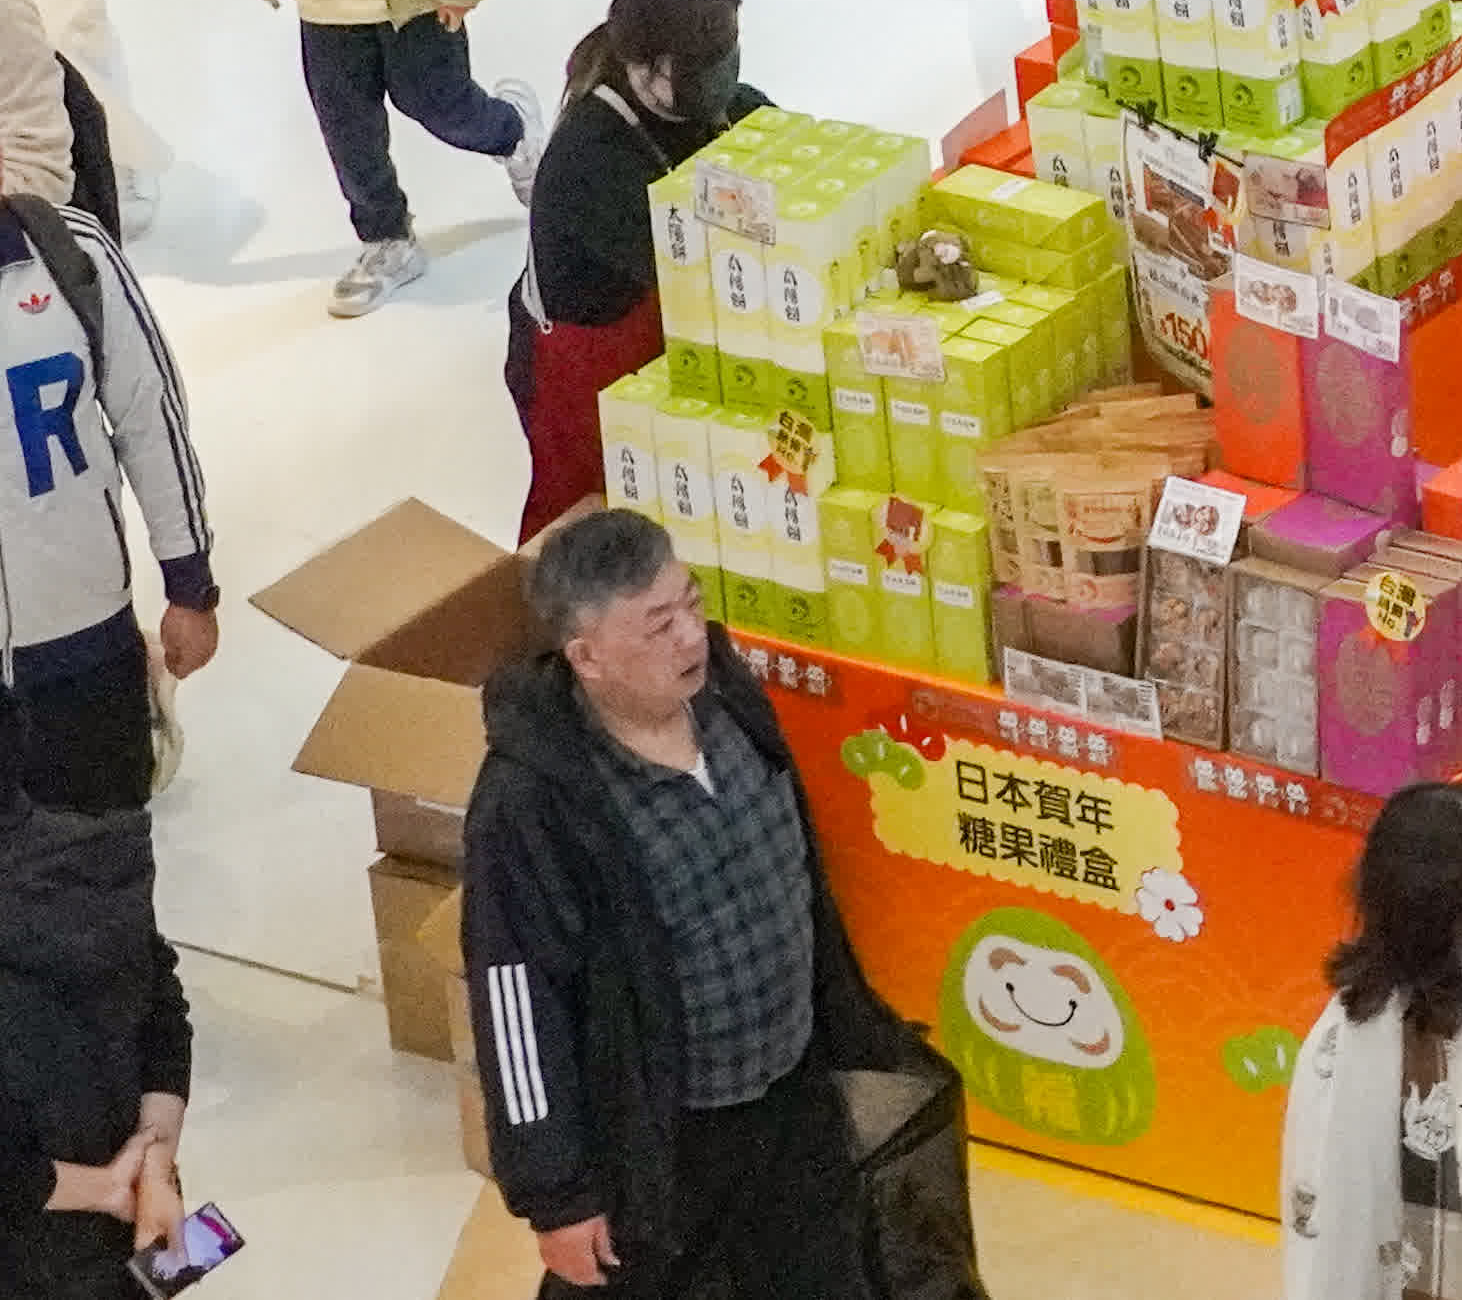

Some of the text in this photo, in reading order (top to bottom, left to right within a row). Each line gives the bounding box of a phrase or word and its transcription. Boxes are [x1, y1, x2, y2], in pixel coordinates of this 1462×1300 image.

[5, 351, 89, 498] R
[956, 759, 1115, 837] 日本賀年
[957, 809, 1121, 893] 糖果禮盒
